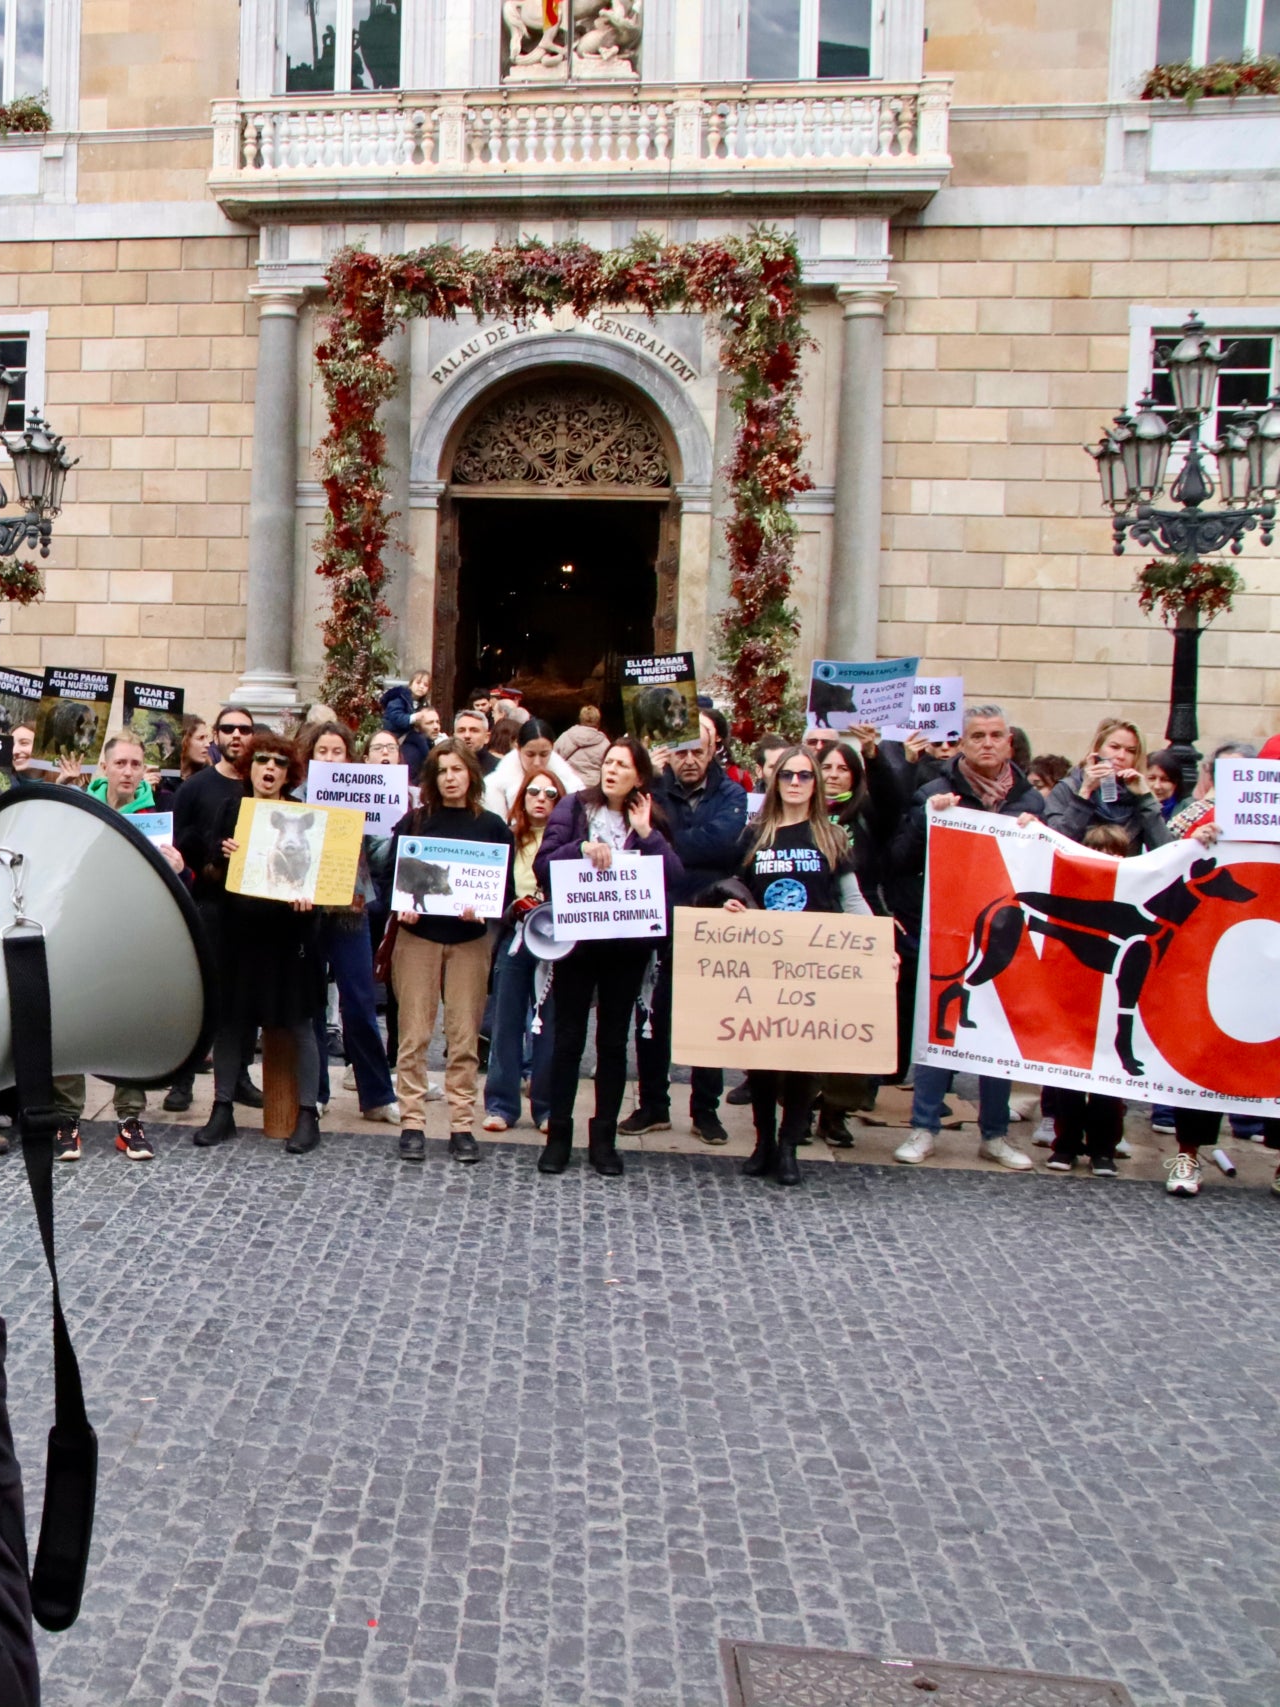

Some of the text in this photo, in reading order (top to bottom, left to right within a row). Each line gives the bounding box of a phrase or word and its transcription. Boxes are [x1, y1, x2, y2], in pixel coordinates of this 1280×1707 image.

[431, 338, 481, 385] PALAU
[485, 325, 510, 346] DE
[591, 316, 697, 384] GENERALITAT
[626, 656, 684, 668] ELLOS PAGAN
[53, 670, 108, 683] ELLOS PAGAN
[624, 664, 688, 676] POR NUESTROS
[31, 679, 44, 689] SU
[49, 678, 109, 692] POR NUESTROS
[637, 674, 677, 685] ERRORES
[21, 686, 43, 698] VIDA
[59, 688, 97, 700] ERRORES
[133, 686, 176, 700] CAZAR ES
[870, 684, 896, 694] FAVOR
[897, 681, 907, 689] DE
[894, 691, 905, 699] EN
[138, 696, 169, 710] MATAR
[860, 702, 904, 716] CONTRA DE
[917, 701, 956, 712] NO DELS
[870, 713, 889, 724] CAZA
[331, 772, 387, 787] CAÇADORS,
[1232, 769, 1254, 782] ELS
[373, 793, 386, 804] DE
[388, 794, 400, 805] LA
[1238, 791, 1280, 804] JUSTIF
[931, 815, 977, 832] Organitza
[1234, 813, 1280, 826] MASSA
[423, 846, 486, 858] #STOPMATANÇA
[776, 848, 820, 860] PLANET.
[461, 867, 501, 878] MENOS
[755, 860, 821, 875] THEIRS TOO!
[578, 871, 593, 883] NO
[619, 869, 637, 881] ELS
[454, 878, 500, 890] BALAS Y
[474, 891, 499, 901] MÁS
[566, 888, 652, 904] SENGLARS, LA
[612, 908, 663, 921] CRIMINAL.
[808, 923, 877, 950] LEYES
[697, 957, 863, 980] PARA PROTEGER
[735, 985, 816, 1007] A LOS
[941, 1046, 995, 1064] indefensa
[1023, 1062, 1044, 1072] una
[1098, 1073, 1122, 1085] més
[1125, 1077, 1149, 1089] dret
[1166, 1085, 1174, 1093] a
[1177, 1087, 1196, 1097] ser
[1199, 1088, 1263, 1104] defensada
